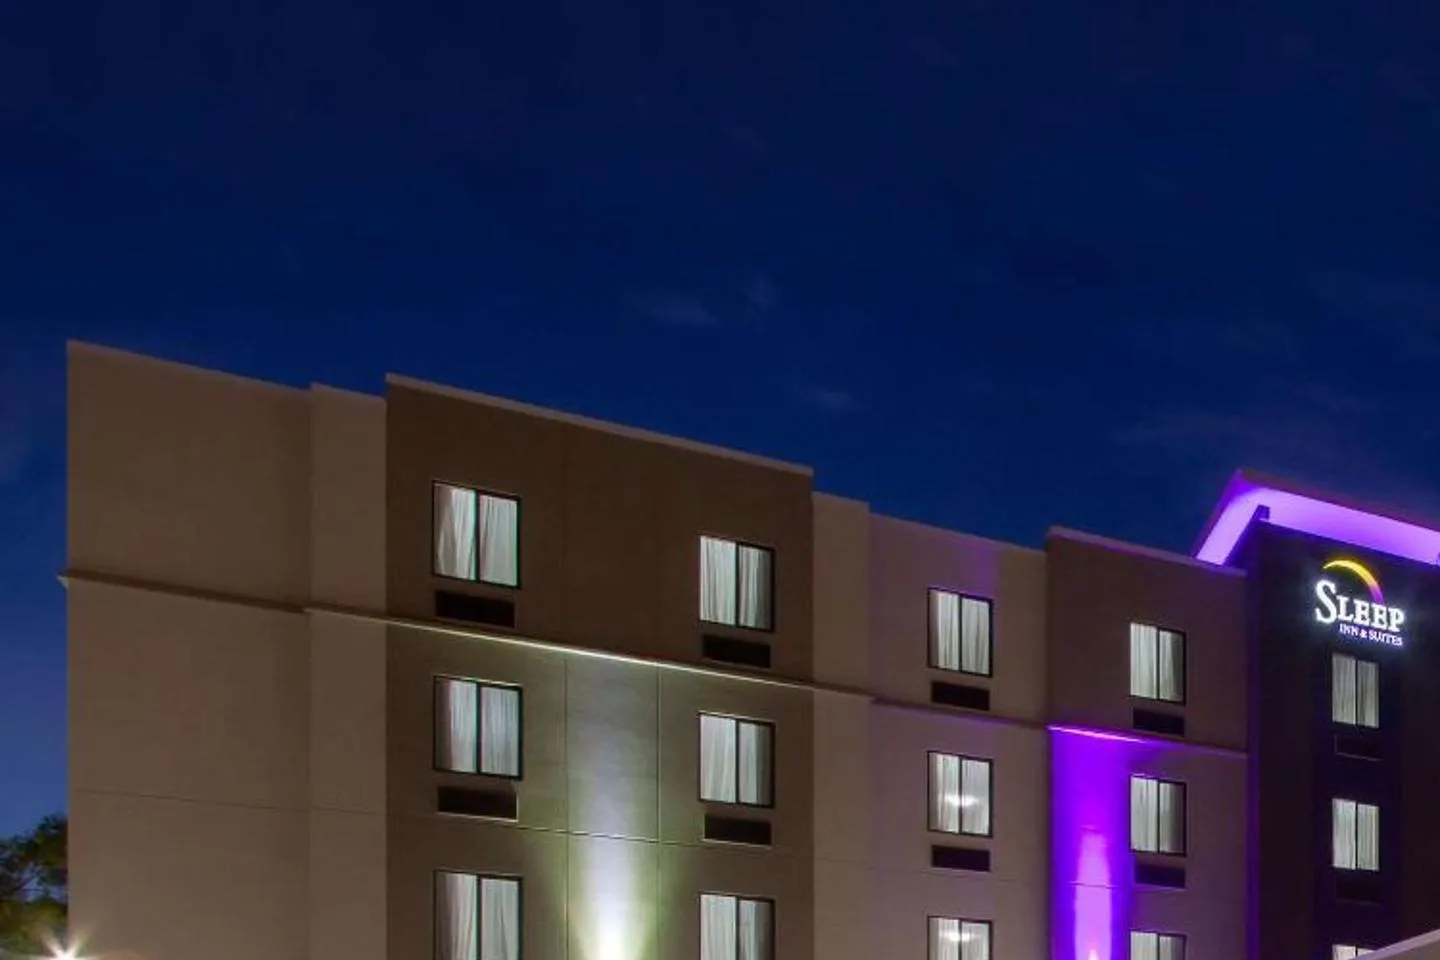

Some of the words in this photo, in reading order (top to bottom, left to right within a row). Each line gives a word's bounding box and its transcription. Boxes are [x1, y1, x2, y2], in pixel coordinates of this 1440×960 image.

[1315, 579, 1405, 632] SLEEP
[1339, 623, 1359, 637] INN
[1359, 628, 1368, 639] &
[1368, 630, 1403, 646] SUITES
